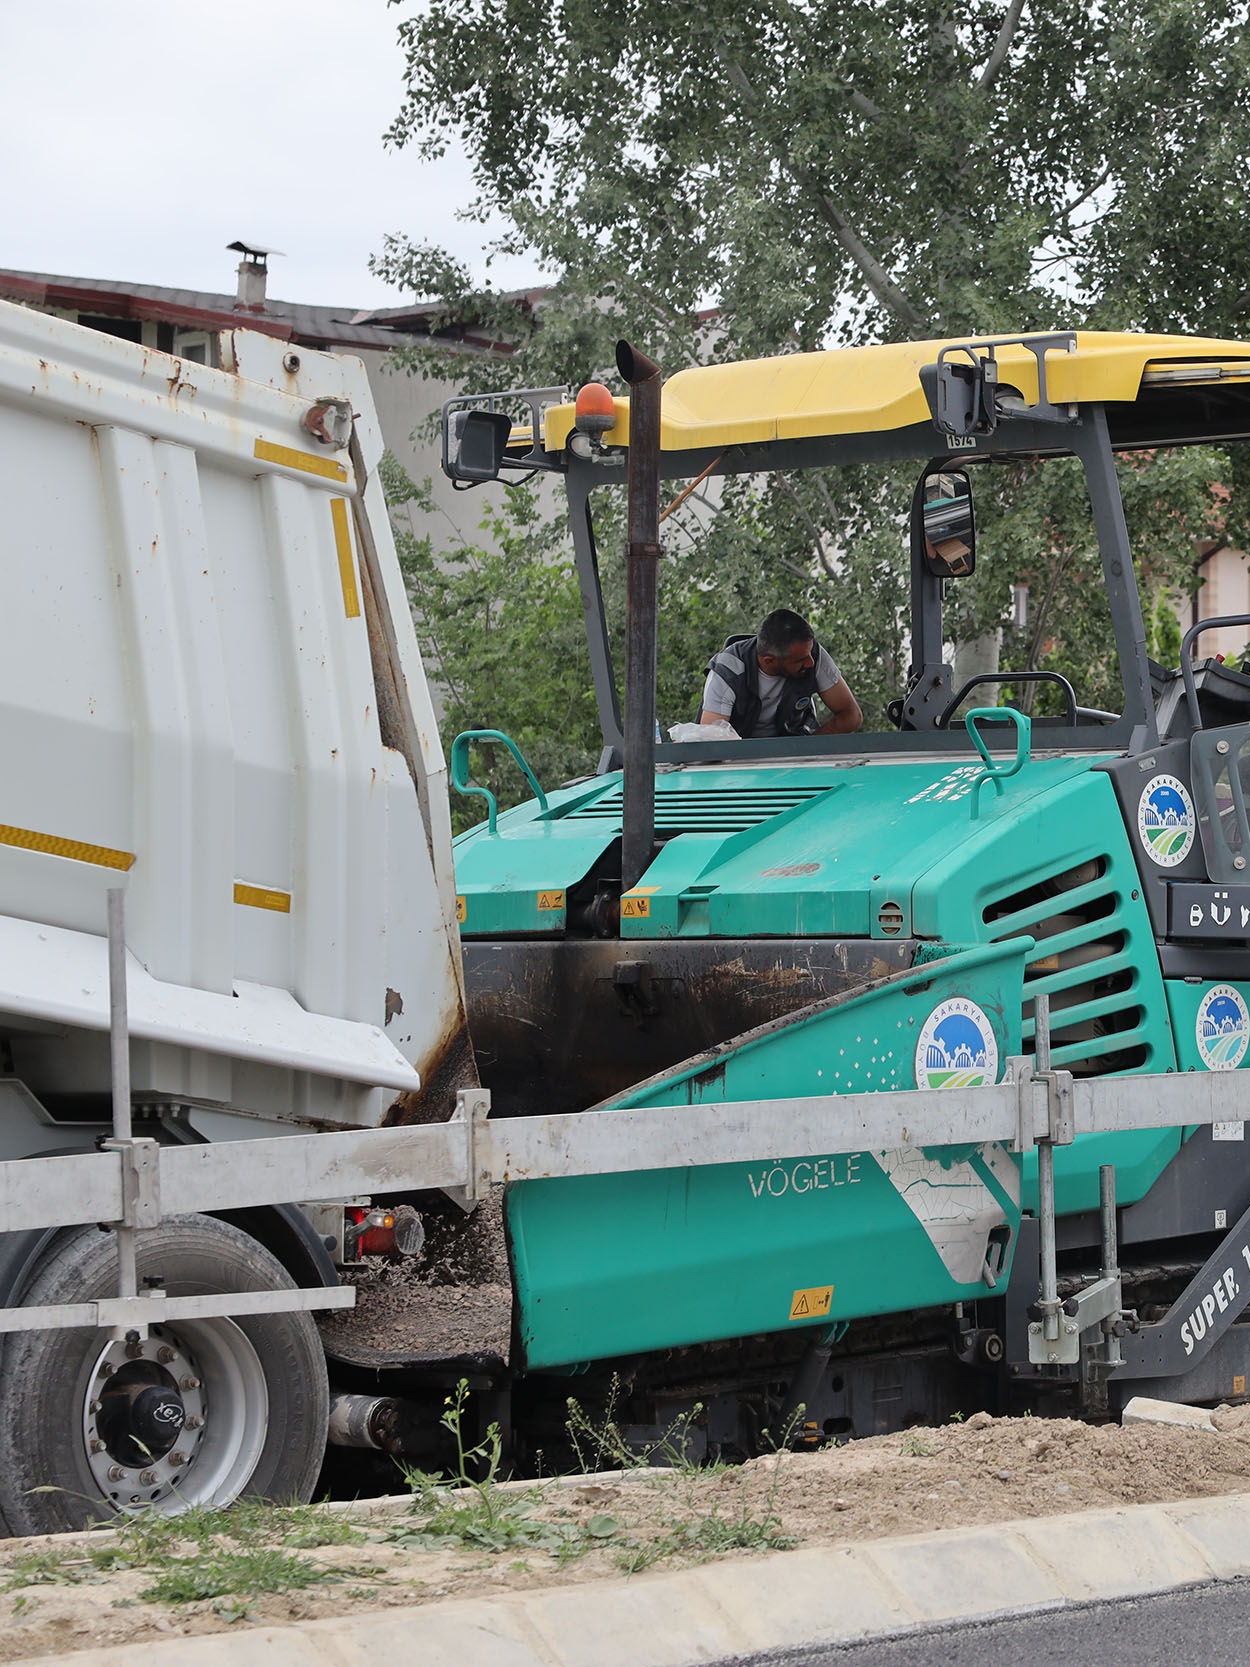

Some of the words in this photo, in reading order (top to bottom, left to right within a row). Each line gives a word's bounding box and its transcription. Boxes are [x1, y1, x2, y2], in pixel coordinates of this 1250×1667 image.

[1147, 779, 1185, 795] SAKARYA
[933, 1003, 982, 1023] SAKARYA
[747, 1153, 862, 1198] VÖGELE
[1180, 1267, 1240, 1356] SUPER
